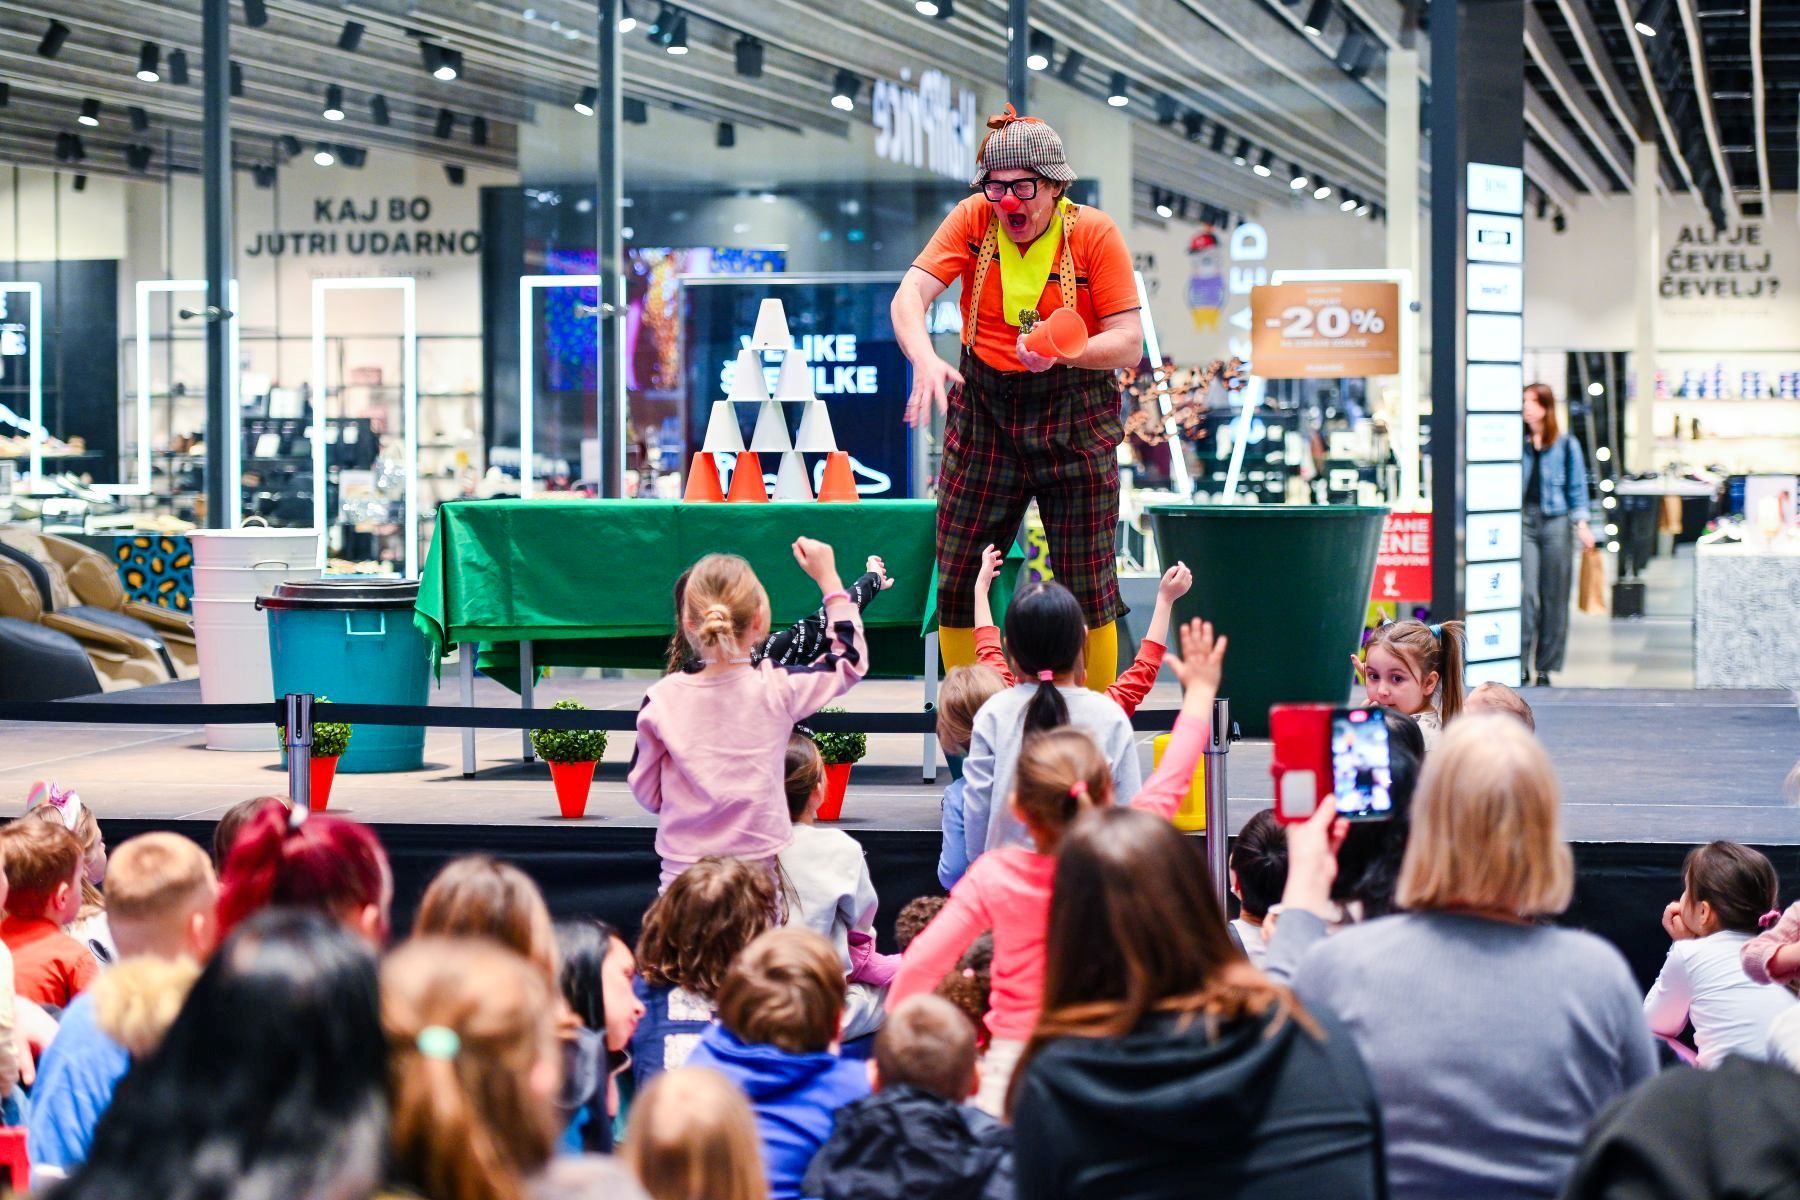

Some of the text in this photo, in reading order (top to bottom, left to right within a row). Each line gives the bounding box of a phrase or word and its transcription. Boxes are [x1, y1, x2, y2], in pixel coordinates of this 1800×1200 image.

[314, 198, 431, 223] KAJ BO
[246, 231, 482, 257] JUTRI UDARNO
[1728, 225, 1762, 245] JE
[1667, 249, 1771, 272] ČEVELJ
[1659, 276, 1780, 298] ČEVELJ?
[1265, 305, 1385, 338] -20%
[740, 334, 857, 362] VIKE
[720, 359, 878, 394] ŠEILKE
